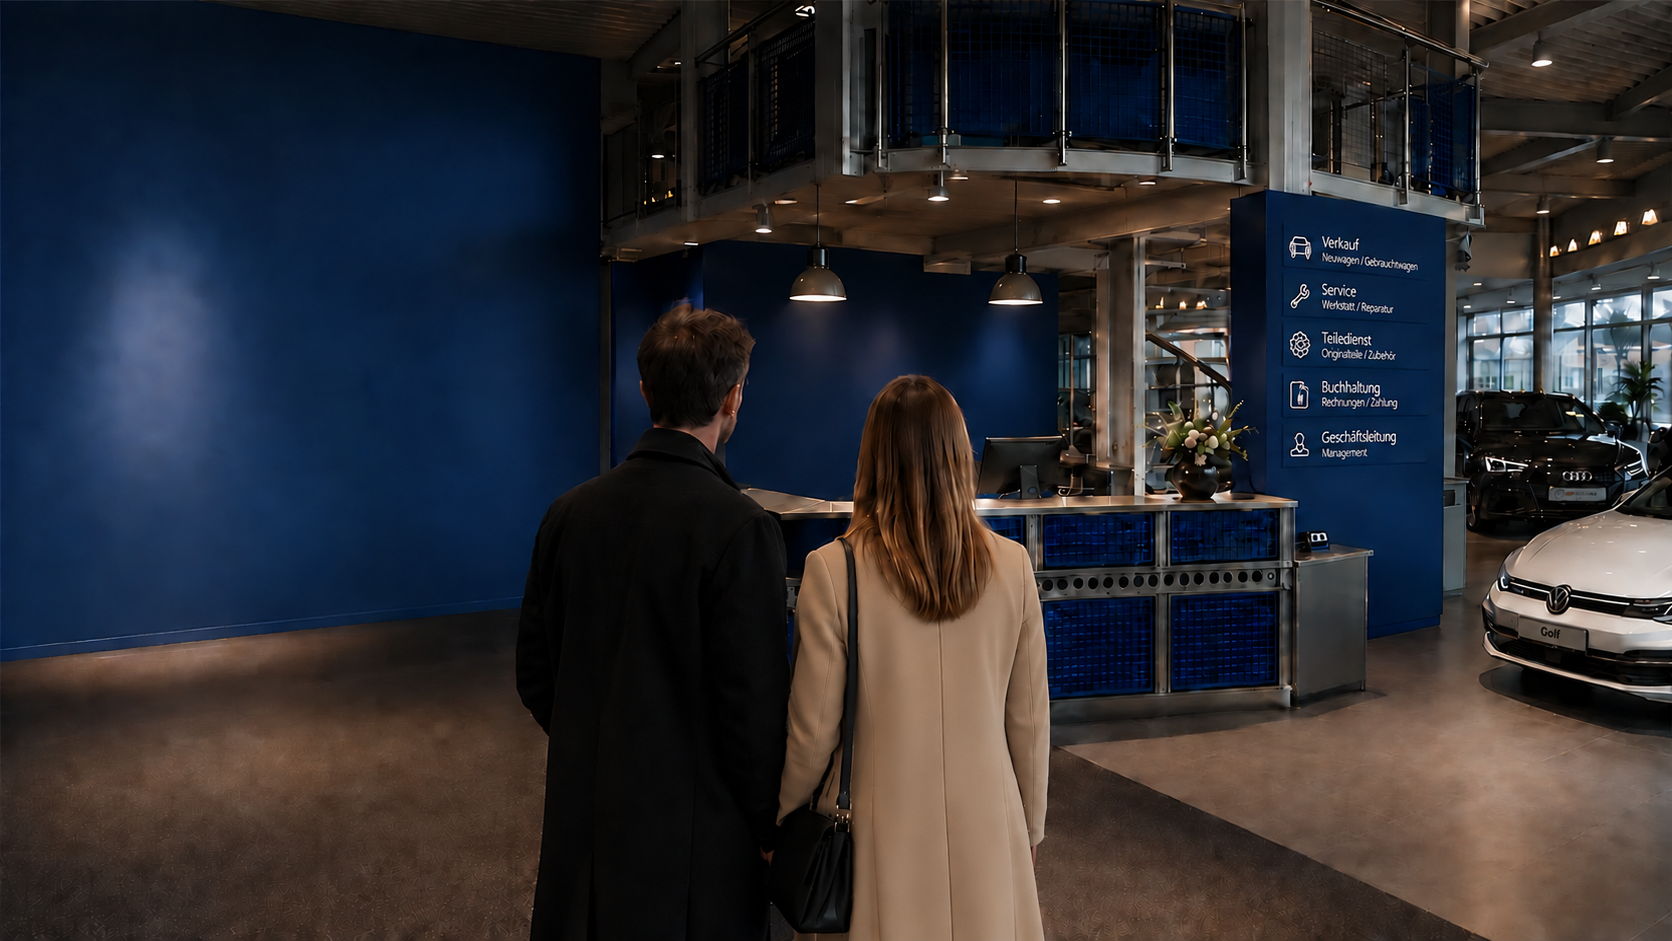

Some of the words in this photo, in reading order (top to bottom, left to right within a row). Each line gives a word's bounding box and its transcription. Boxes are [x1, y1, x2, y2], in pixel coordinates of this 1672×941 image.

[1321, 236, 1359, 251] Verkauf
[1321, 252, 1360, 267] Neuwagen
[1321, 283, 1357, 298] Service
[1321, 300, 1355, 311] Werkstatt
[1361, 302, 1394, 314] Reparatur
[1321, 331, 1372, 346] Teiledienst
[1321, 380, 1381, 397] Buchhaltung
[1321, 397, 1366, 409] Rechnungen
[1370, 398, 1398, 410] Zahlung
[1321, 430, 1397, 445] Geschäftsleitung
[1541, 627, 1561, 639] Golf
